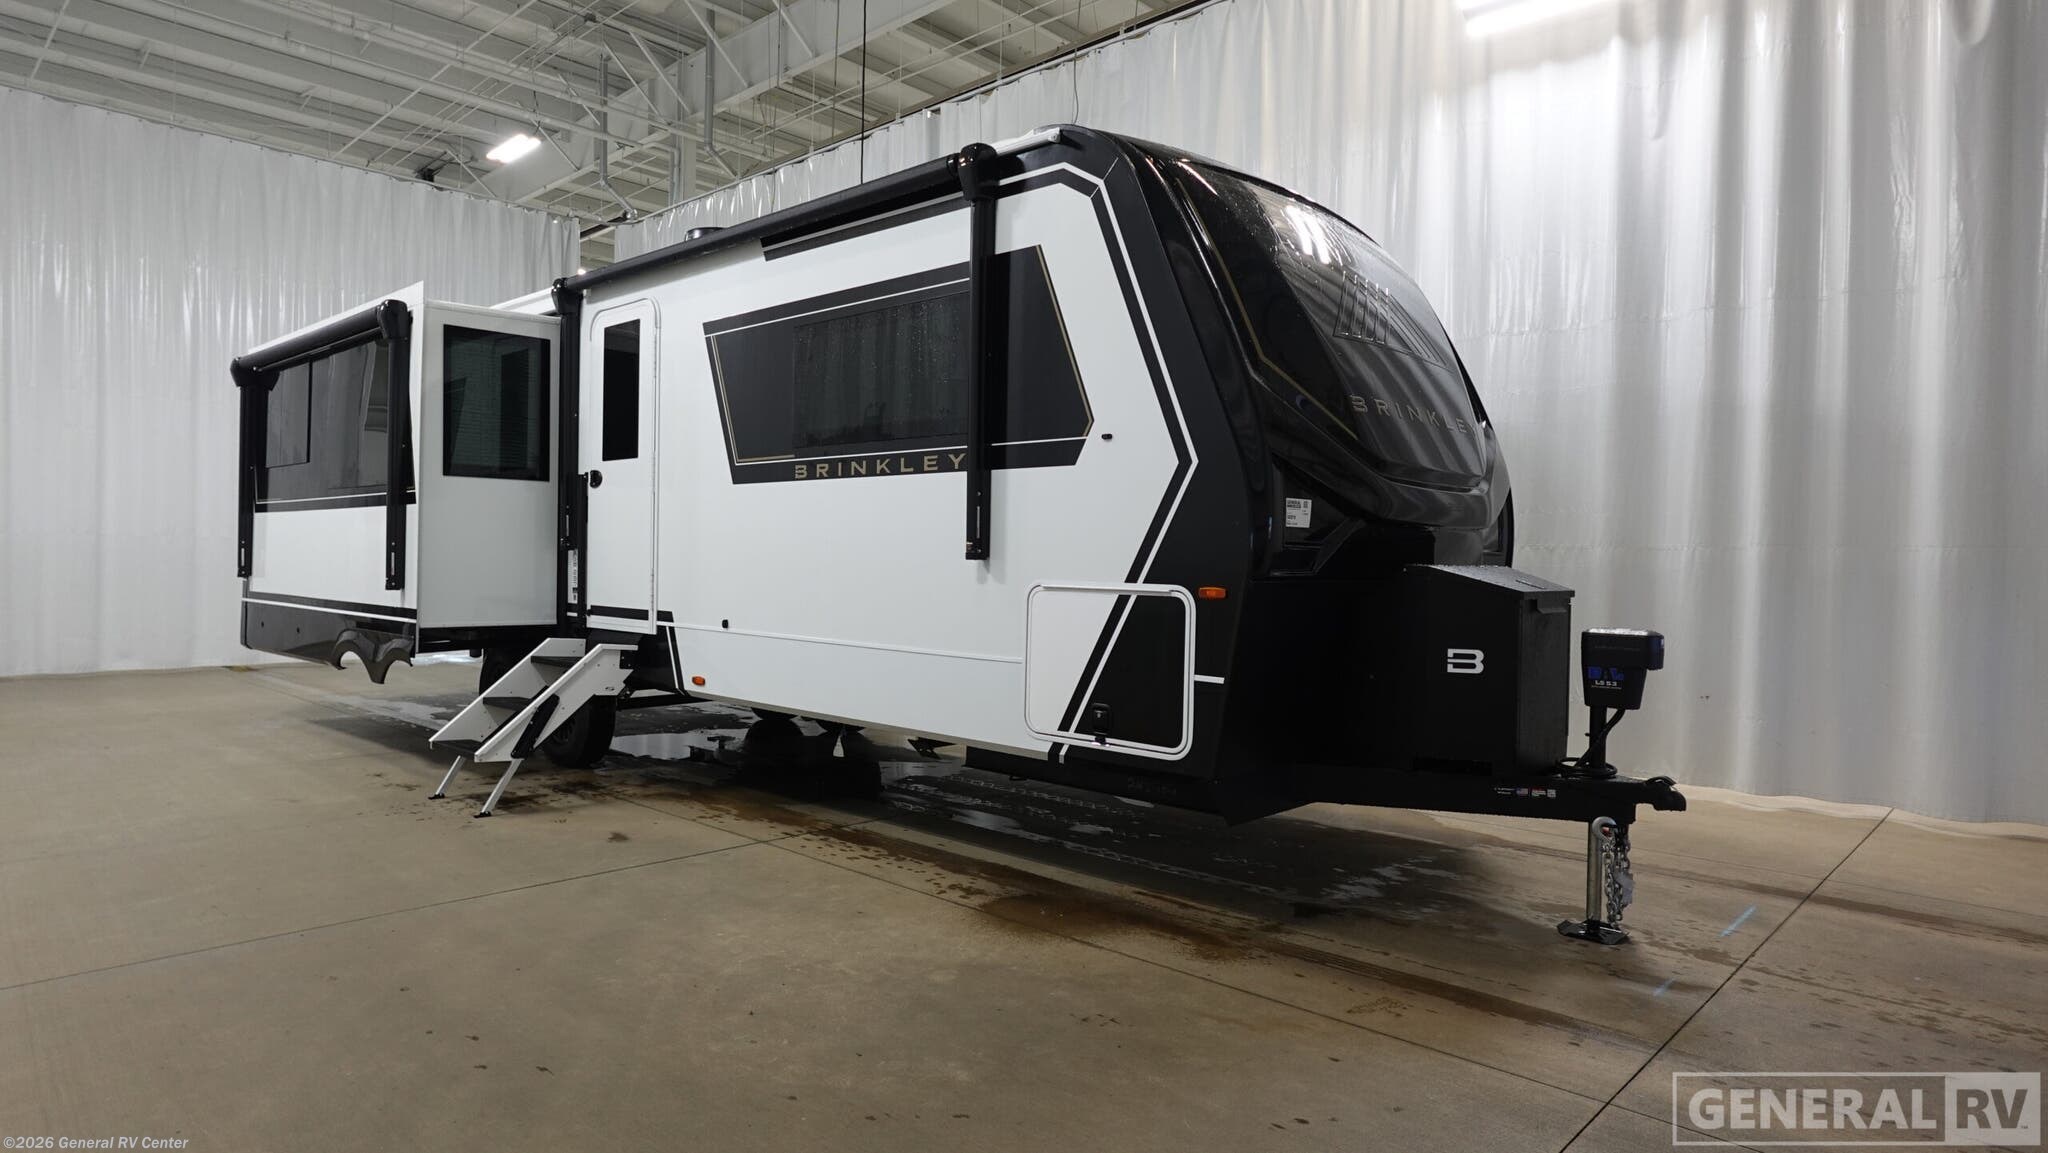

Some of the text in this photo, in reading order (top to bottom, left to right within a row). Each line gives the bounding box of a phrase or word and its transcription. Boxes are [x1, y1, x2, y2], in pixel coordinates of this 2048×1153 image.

[1350, 394, 1473, 435] BRINKLE
[794, 452, 967, 480] BRINKLEY
[1447, 648, 1485, 674] B
